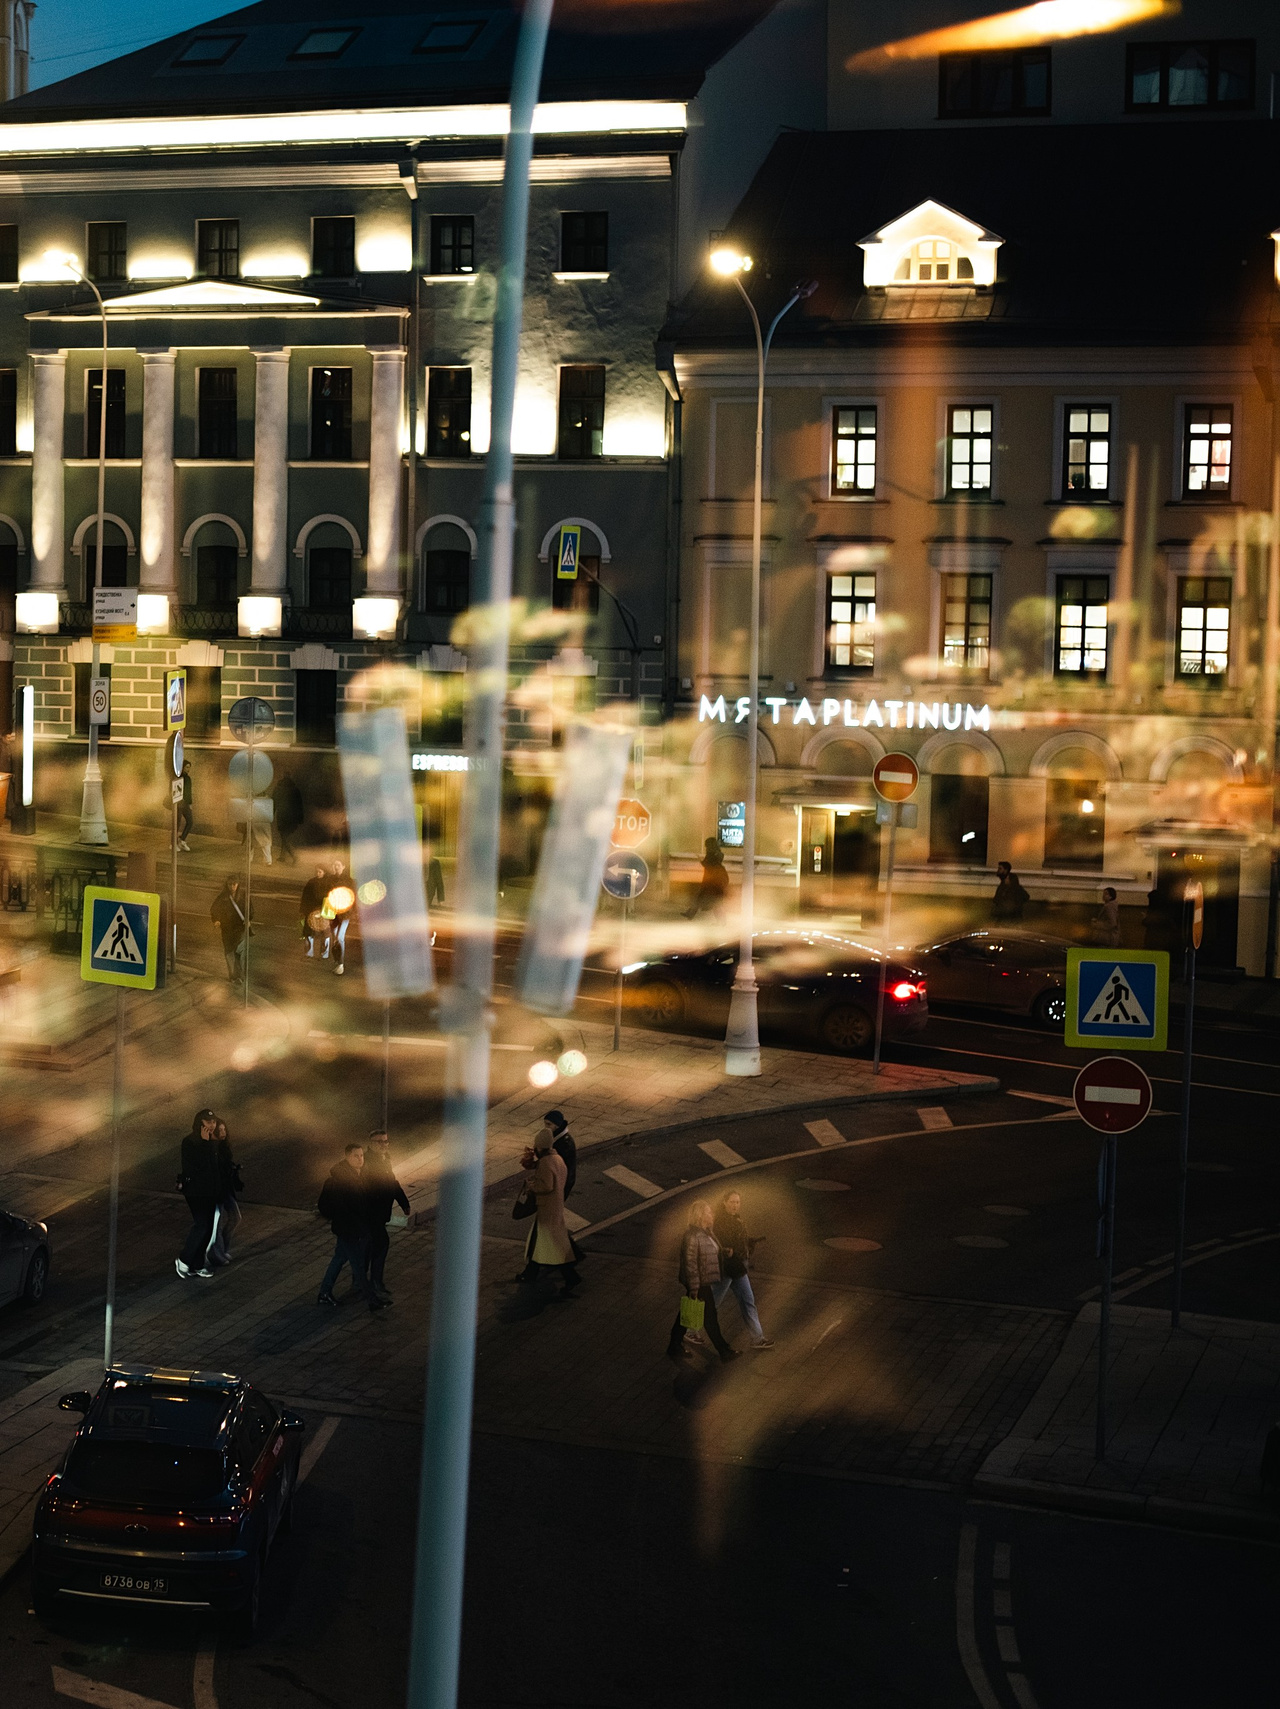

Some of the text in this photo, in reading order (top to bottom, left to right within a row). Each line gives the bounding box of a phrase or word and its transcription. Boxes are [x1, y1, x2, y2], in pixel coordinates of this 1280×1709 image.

[95, 696, 104, 707] 50
[615, 815, 648, 831] TOP
[104, 1574, 133, 1588] 8738
[153, 1578, 165, 1588] 15
